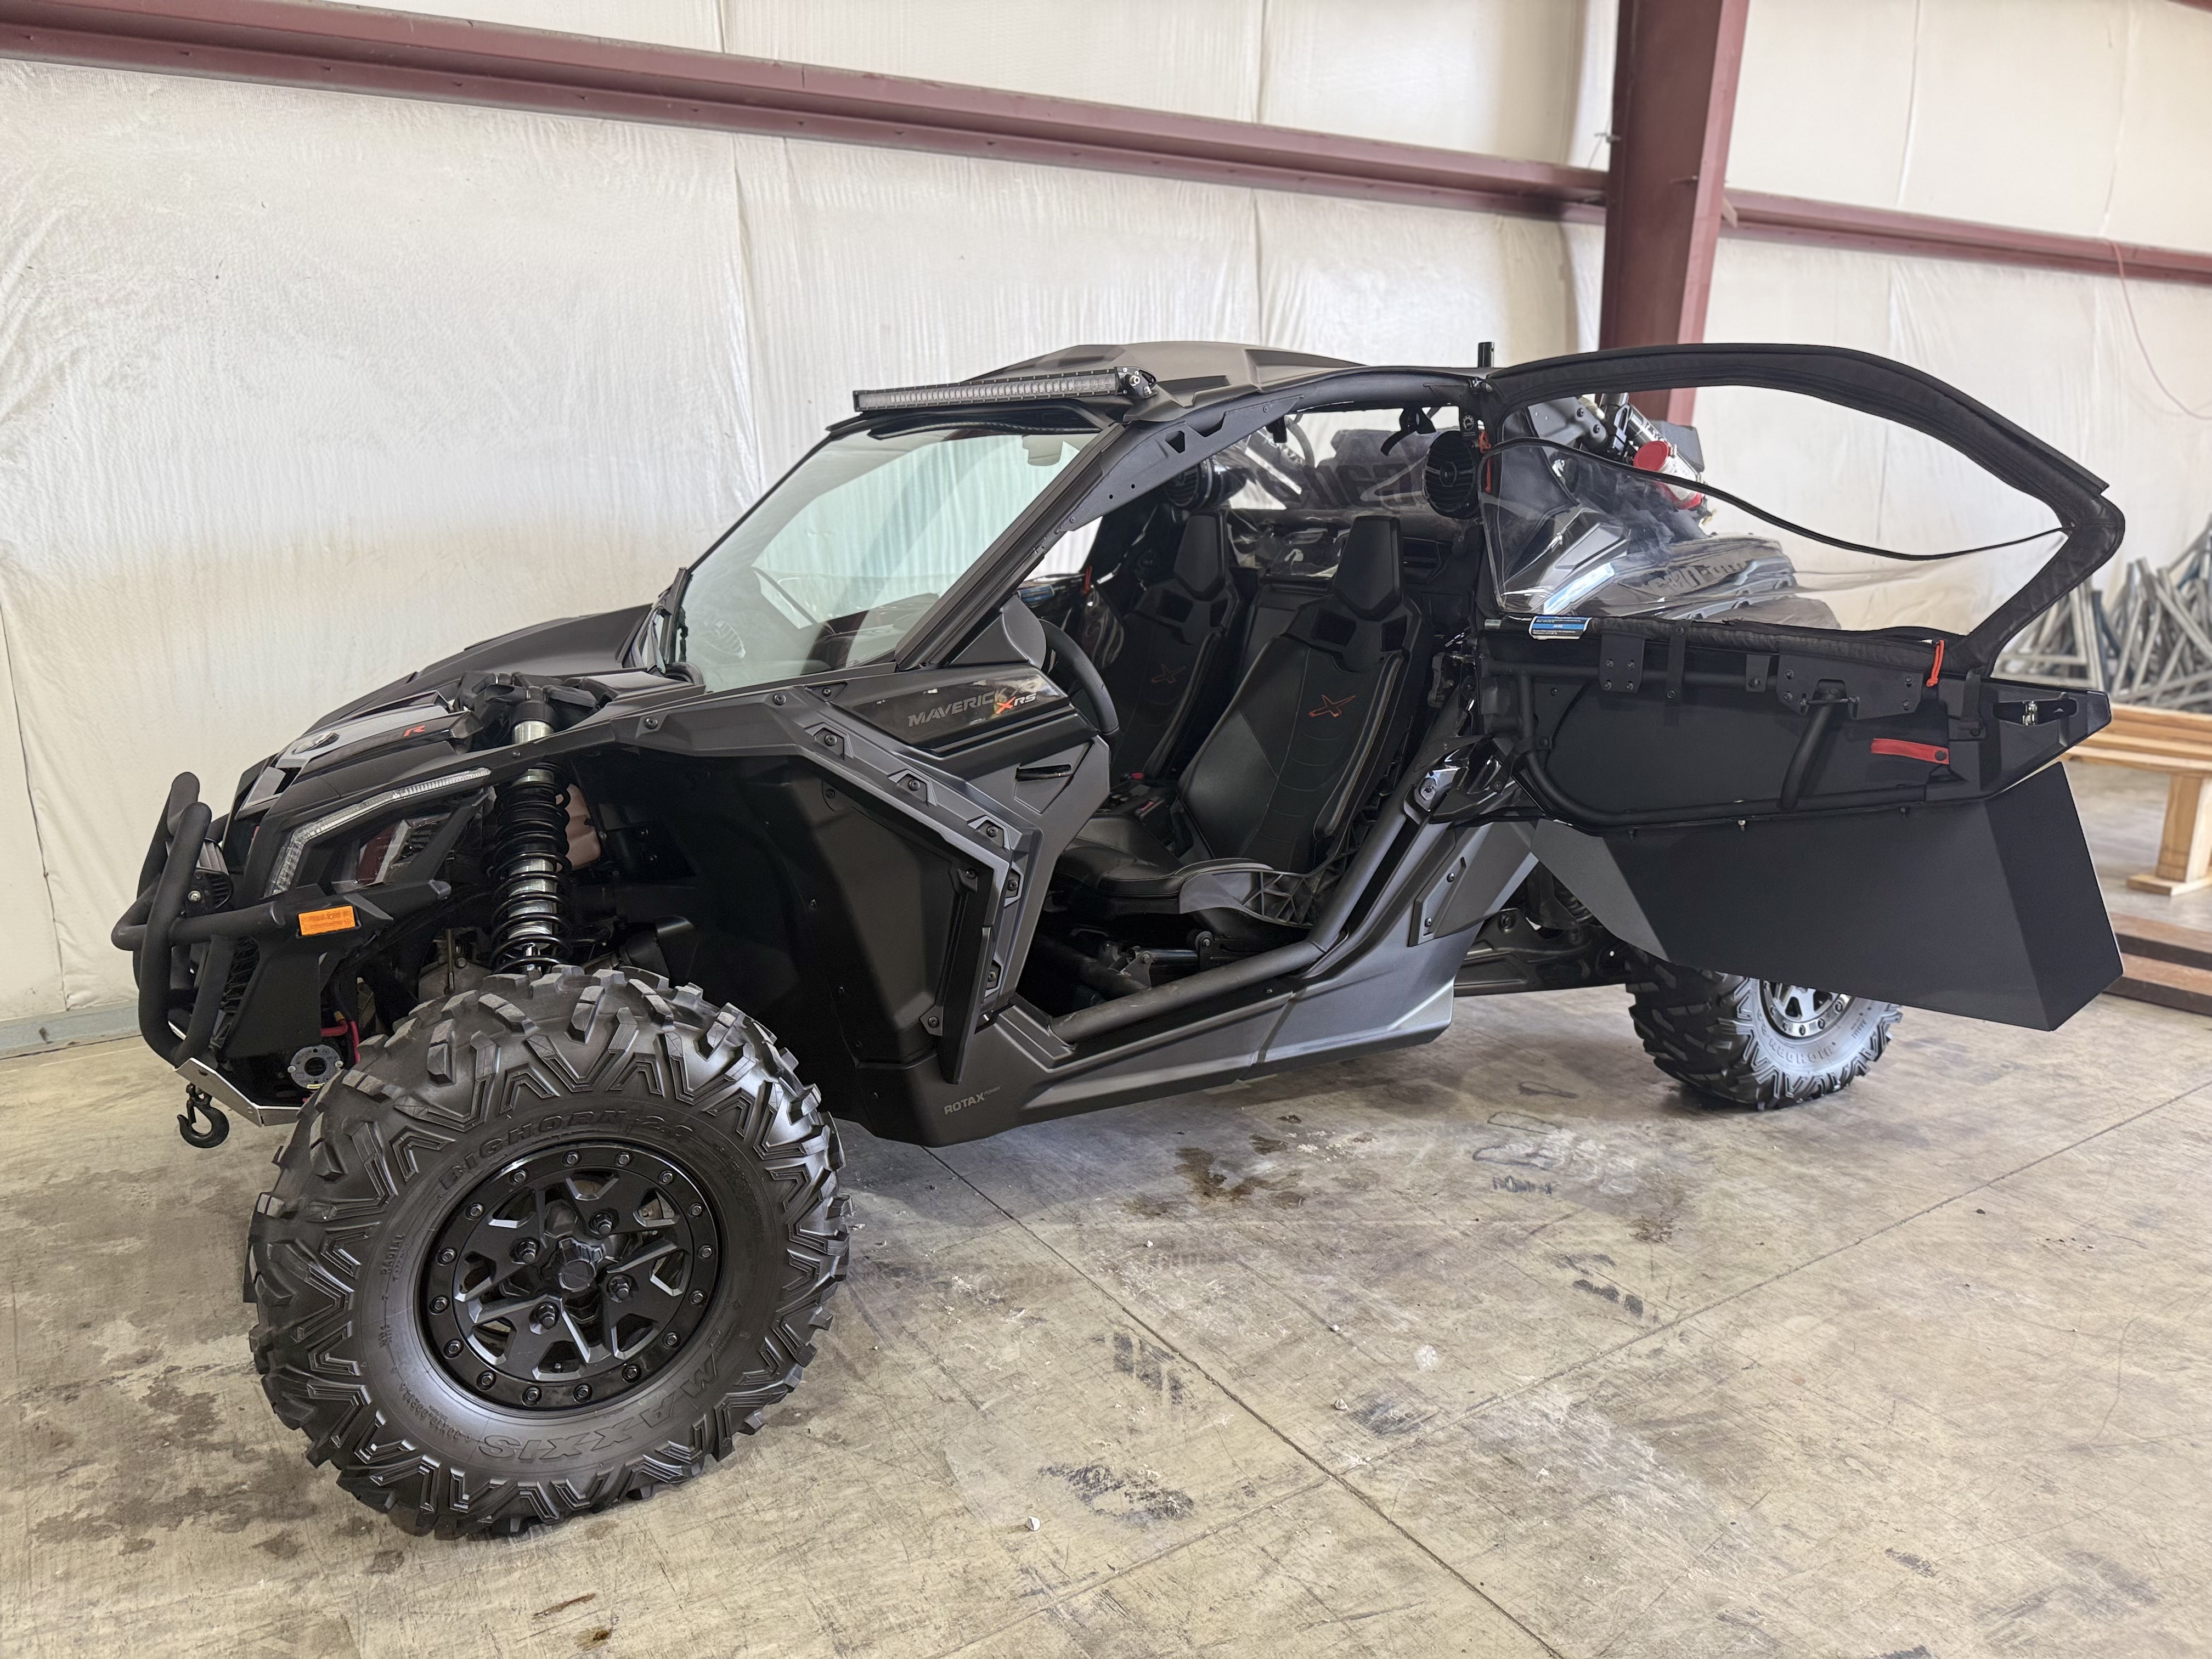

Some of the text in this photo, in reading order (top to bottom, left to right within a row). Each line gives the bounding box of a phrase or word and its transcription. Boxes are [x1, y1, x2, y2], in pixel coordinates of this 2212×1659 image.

[907, 687, 1008, 727] MAVERICK
[944, 1092, 985, 1115] ROTAX
[438, 1108, 628, 1189] BIGHORN
[477, 1352, 717, 1463] MAXXIS
